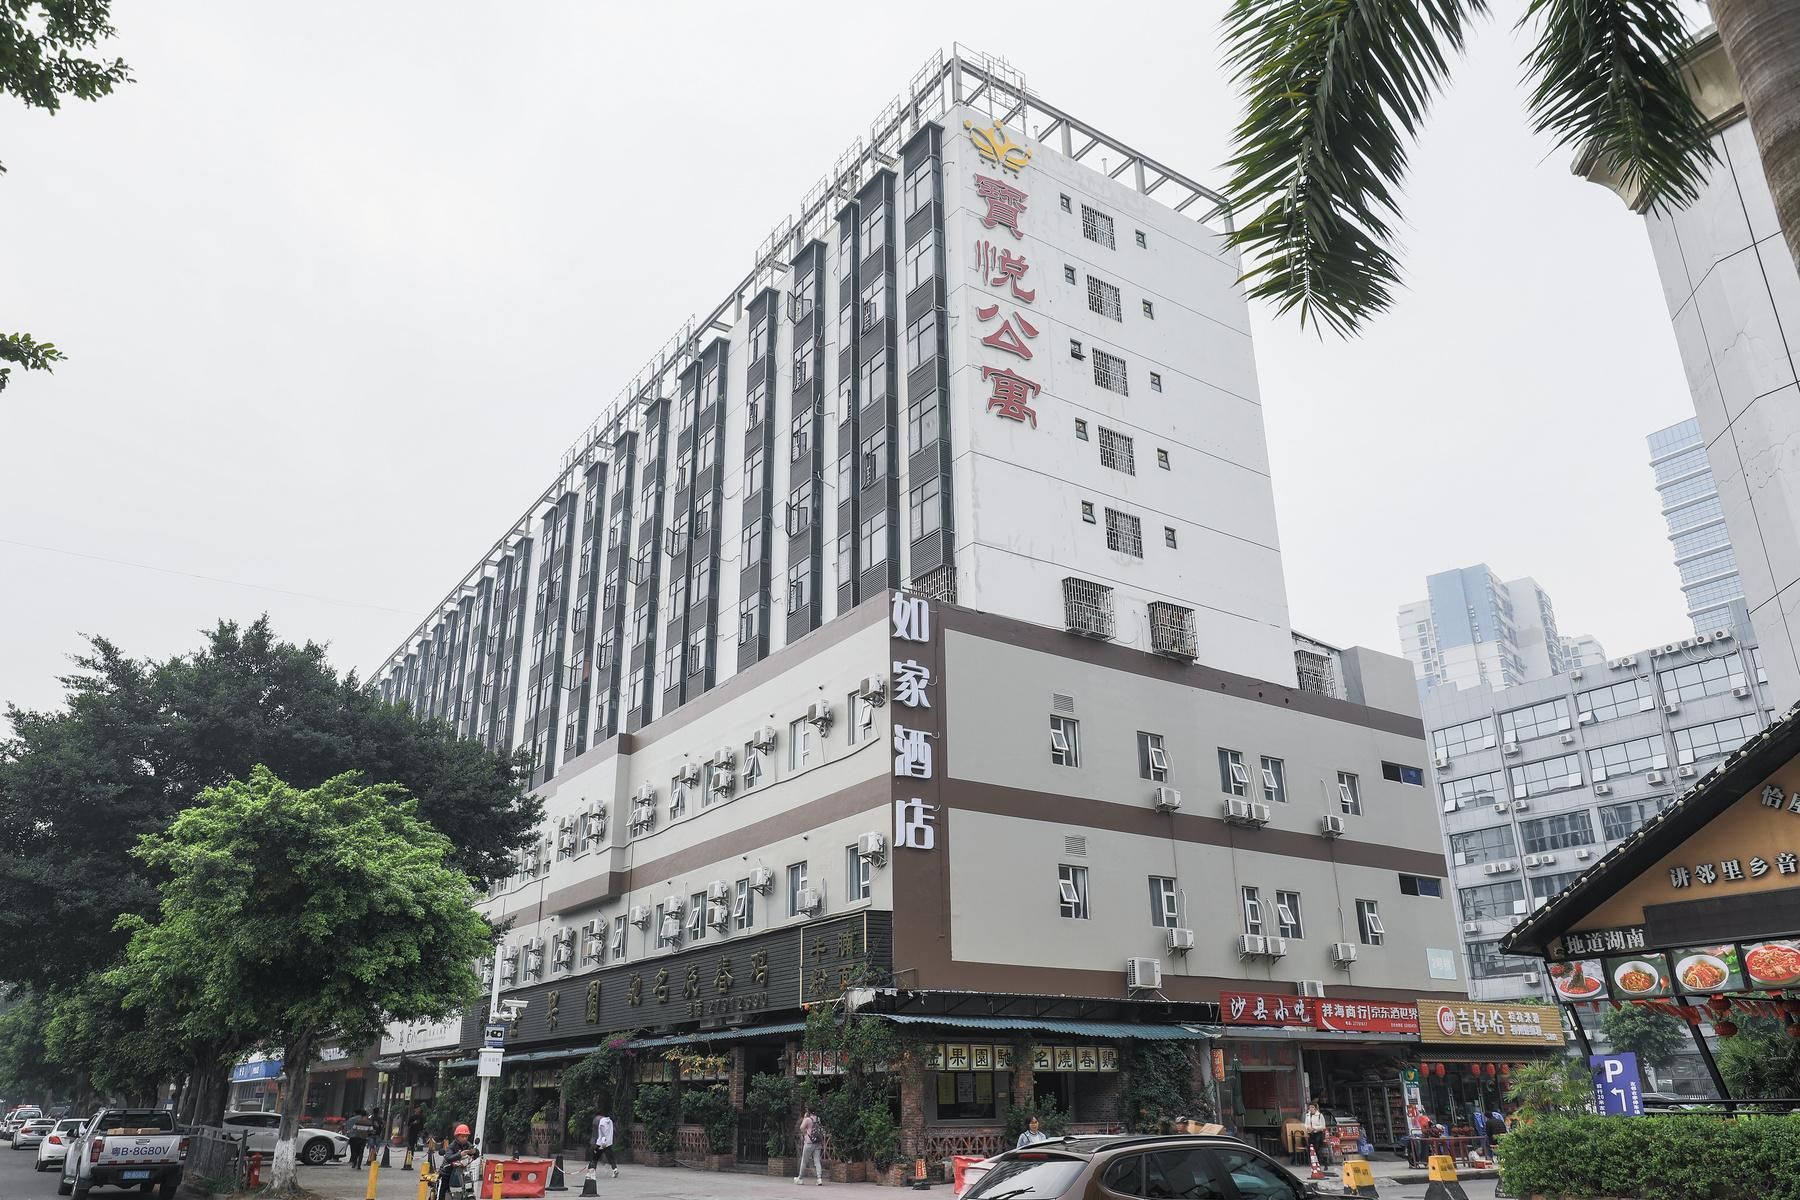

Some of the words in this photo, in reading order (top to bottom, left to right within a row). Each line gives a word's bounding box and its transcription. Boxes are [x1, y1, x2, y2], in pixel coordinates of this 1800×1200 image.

[891, 592, 935, 849] 如家酒店
[1669, 852, 1797, 888] 讲邻里乡音
[1566, 928, 1645, 954] 地道湖南
[1231, 995, 1310, 1022] 沙县小吃
[1322, 1003, 1367, 1019] 祥海商行
[1371, 1006, 1418, 1020] 京东酒世界
[1457, 1008, 1504, 1035] 吉好恰
[1604, 1059, 1623, 1083] P
